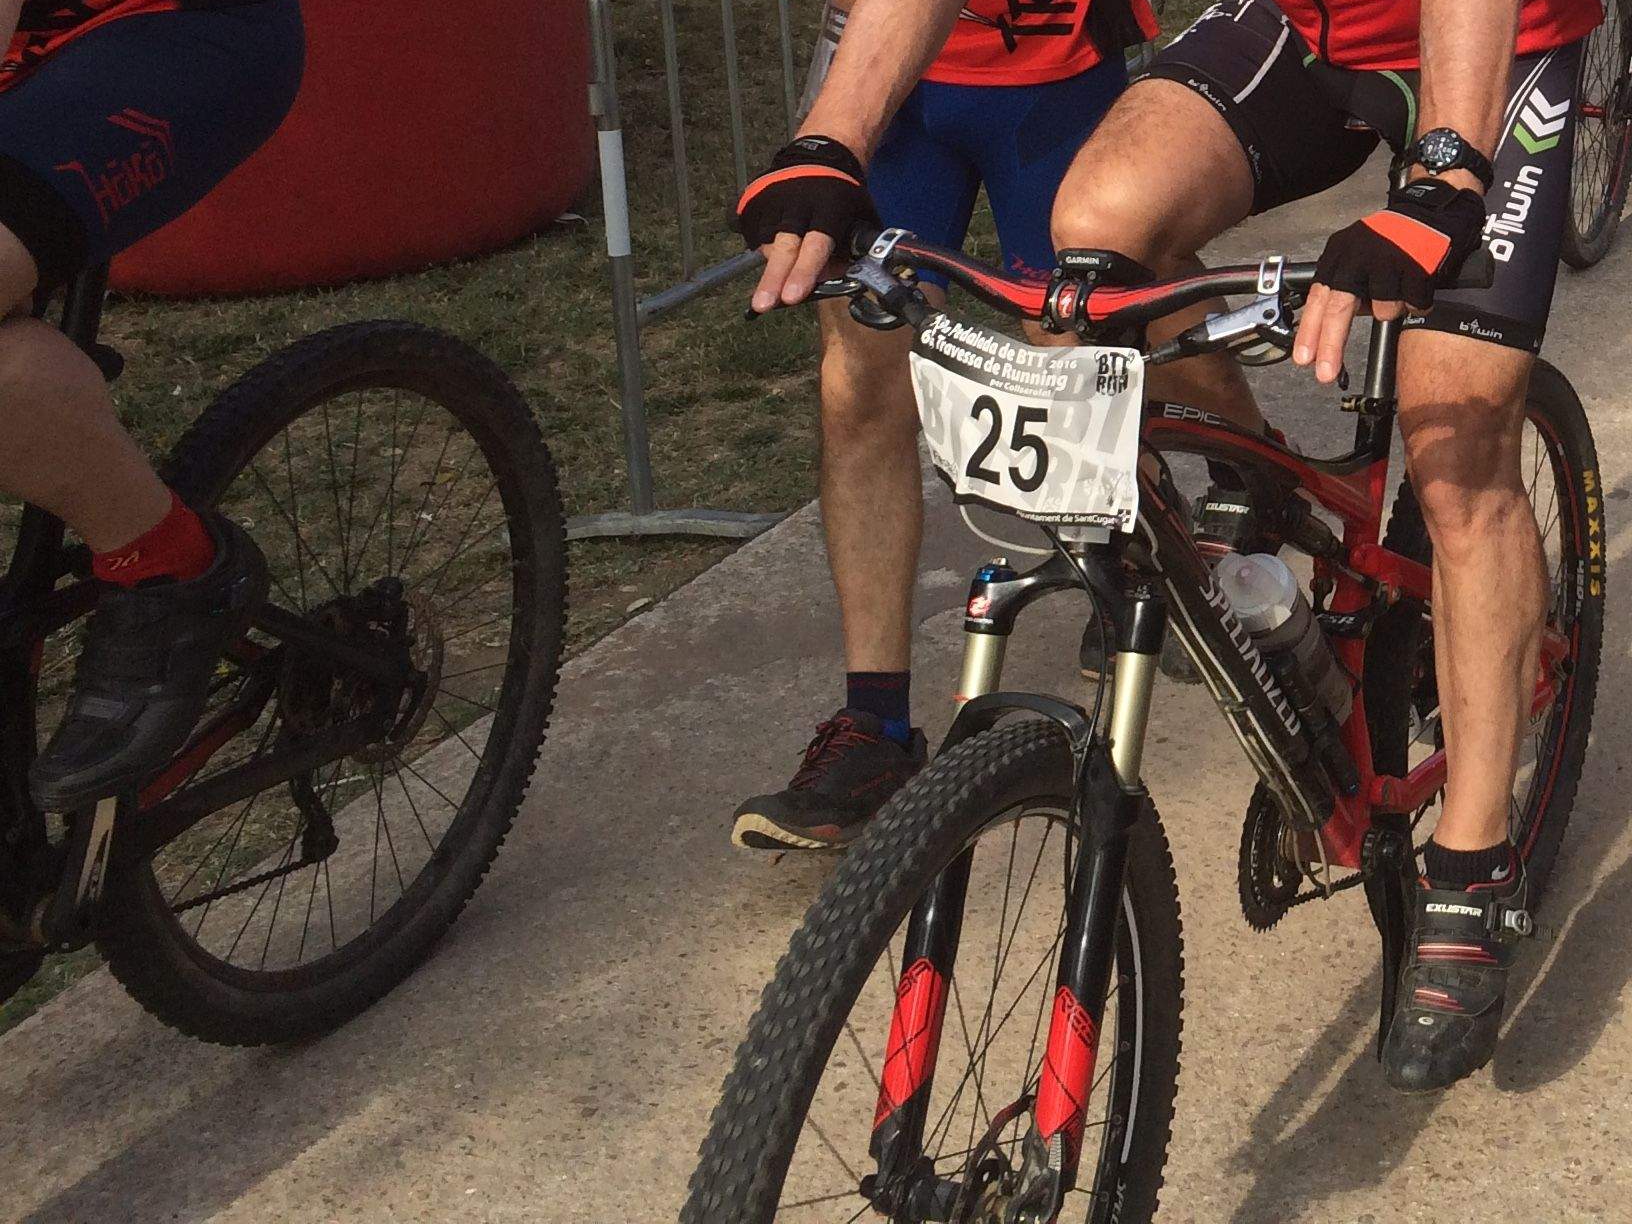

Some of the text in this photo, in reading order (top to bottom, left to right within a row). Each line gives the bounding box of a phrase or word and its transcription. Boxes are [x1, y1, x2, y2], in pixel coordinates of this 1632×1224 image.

[1065, 256, 1100, 265] GARMIN
[935, 333, 984, 369] Travessa
[984, 356, 1001, 376] de
[1002, 363, 1069, 392] Running
[999, 342, 1016, 362] de
[1016, 349, 1049, 369] BTT
[1049, 359, 1078, 370] 2016
[1163, 402, 1222, 425] EPIC
[965, 394, 1050, 492] 25
[1583, 469, 1602, 597] MAXXIS
[1199, 574, 1302, 737] SPECIALIZED
[1425, 902, 1483, 917] EXUSTAR
